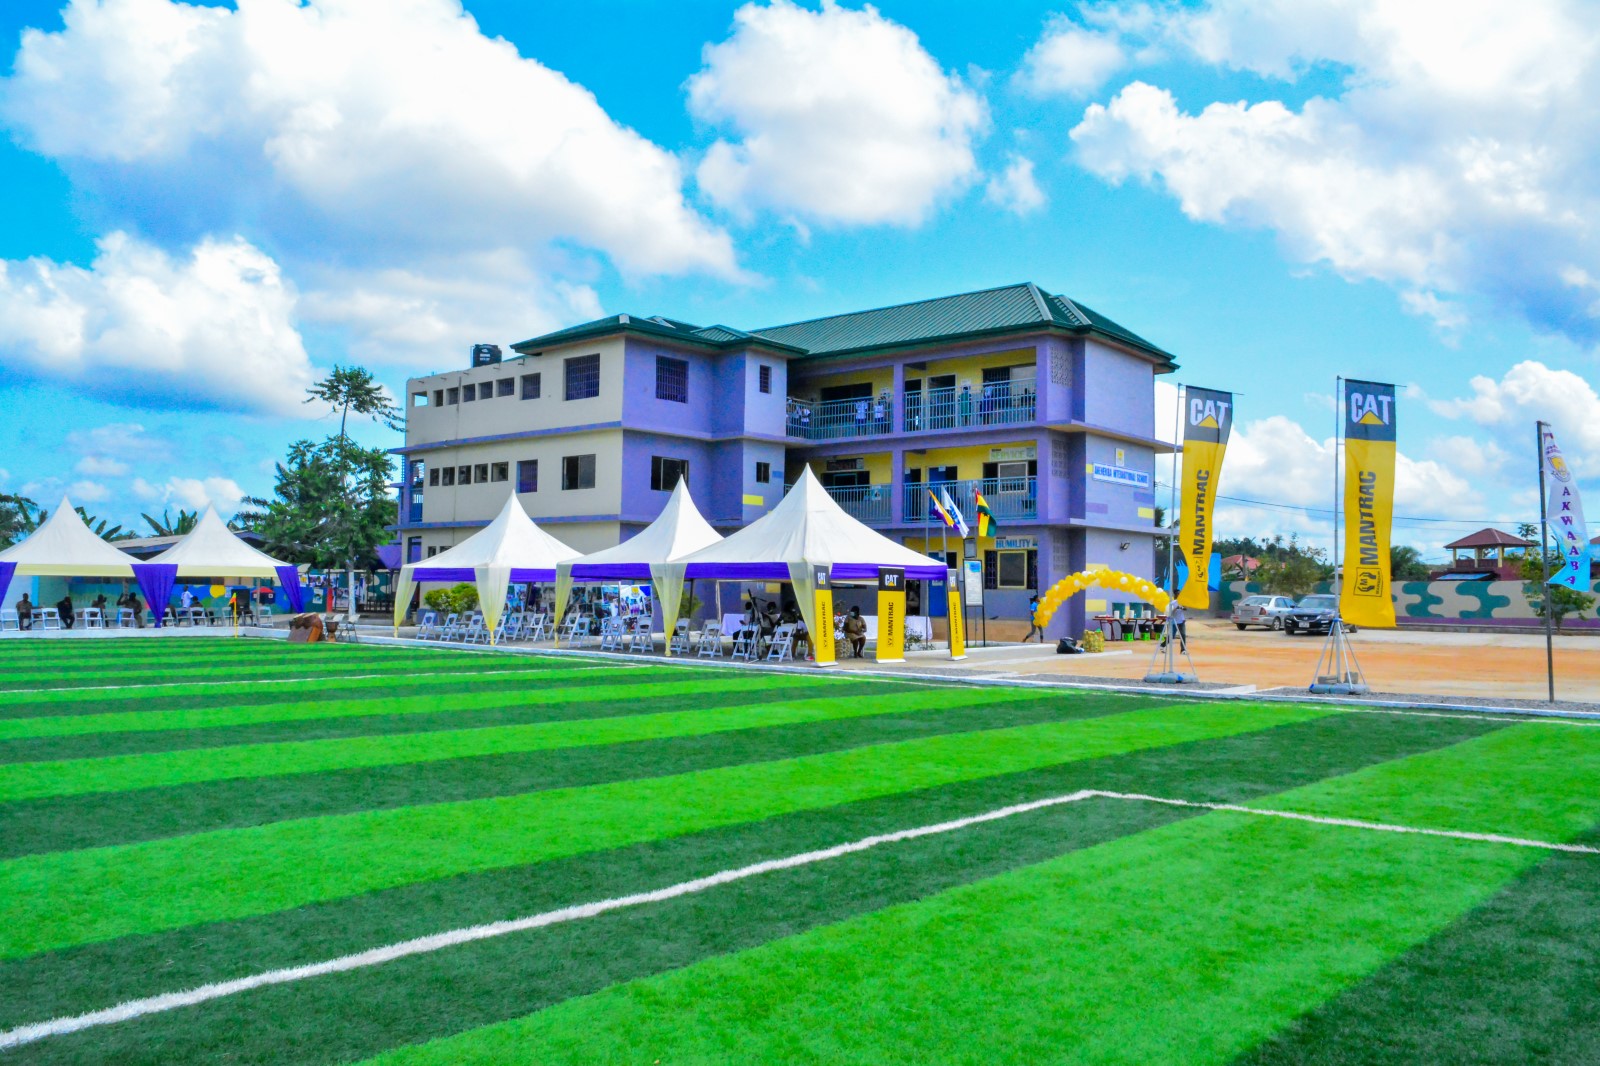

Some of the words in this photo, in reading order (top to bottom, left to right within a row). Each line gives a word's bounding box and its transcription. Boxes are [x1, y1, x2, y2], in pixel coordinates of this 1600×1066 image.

[1190, 398, 1229, 429] CAT
[1351, 392, 1392, 425] CAT
[1193, 469, 1210, 555] MANTRAC
[1359, 470, 1379, 565] MANTRAC
[996, 539, 1031, 548] HUMILITY
[1560, 486, 1580, 585] AKWAABA
[817, 572, 826, 585] CAT
[884, 574, 899, 587] CAT
